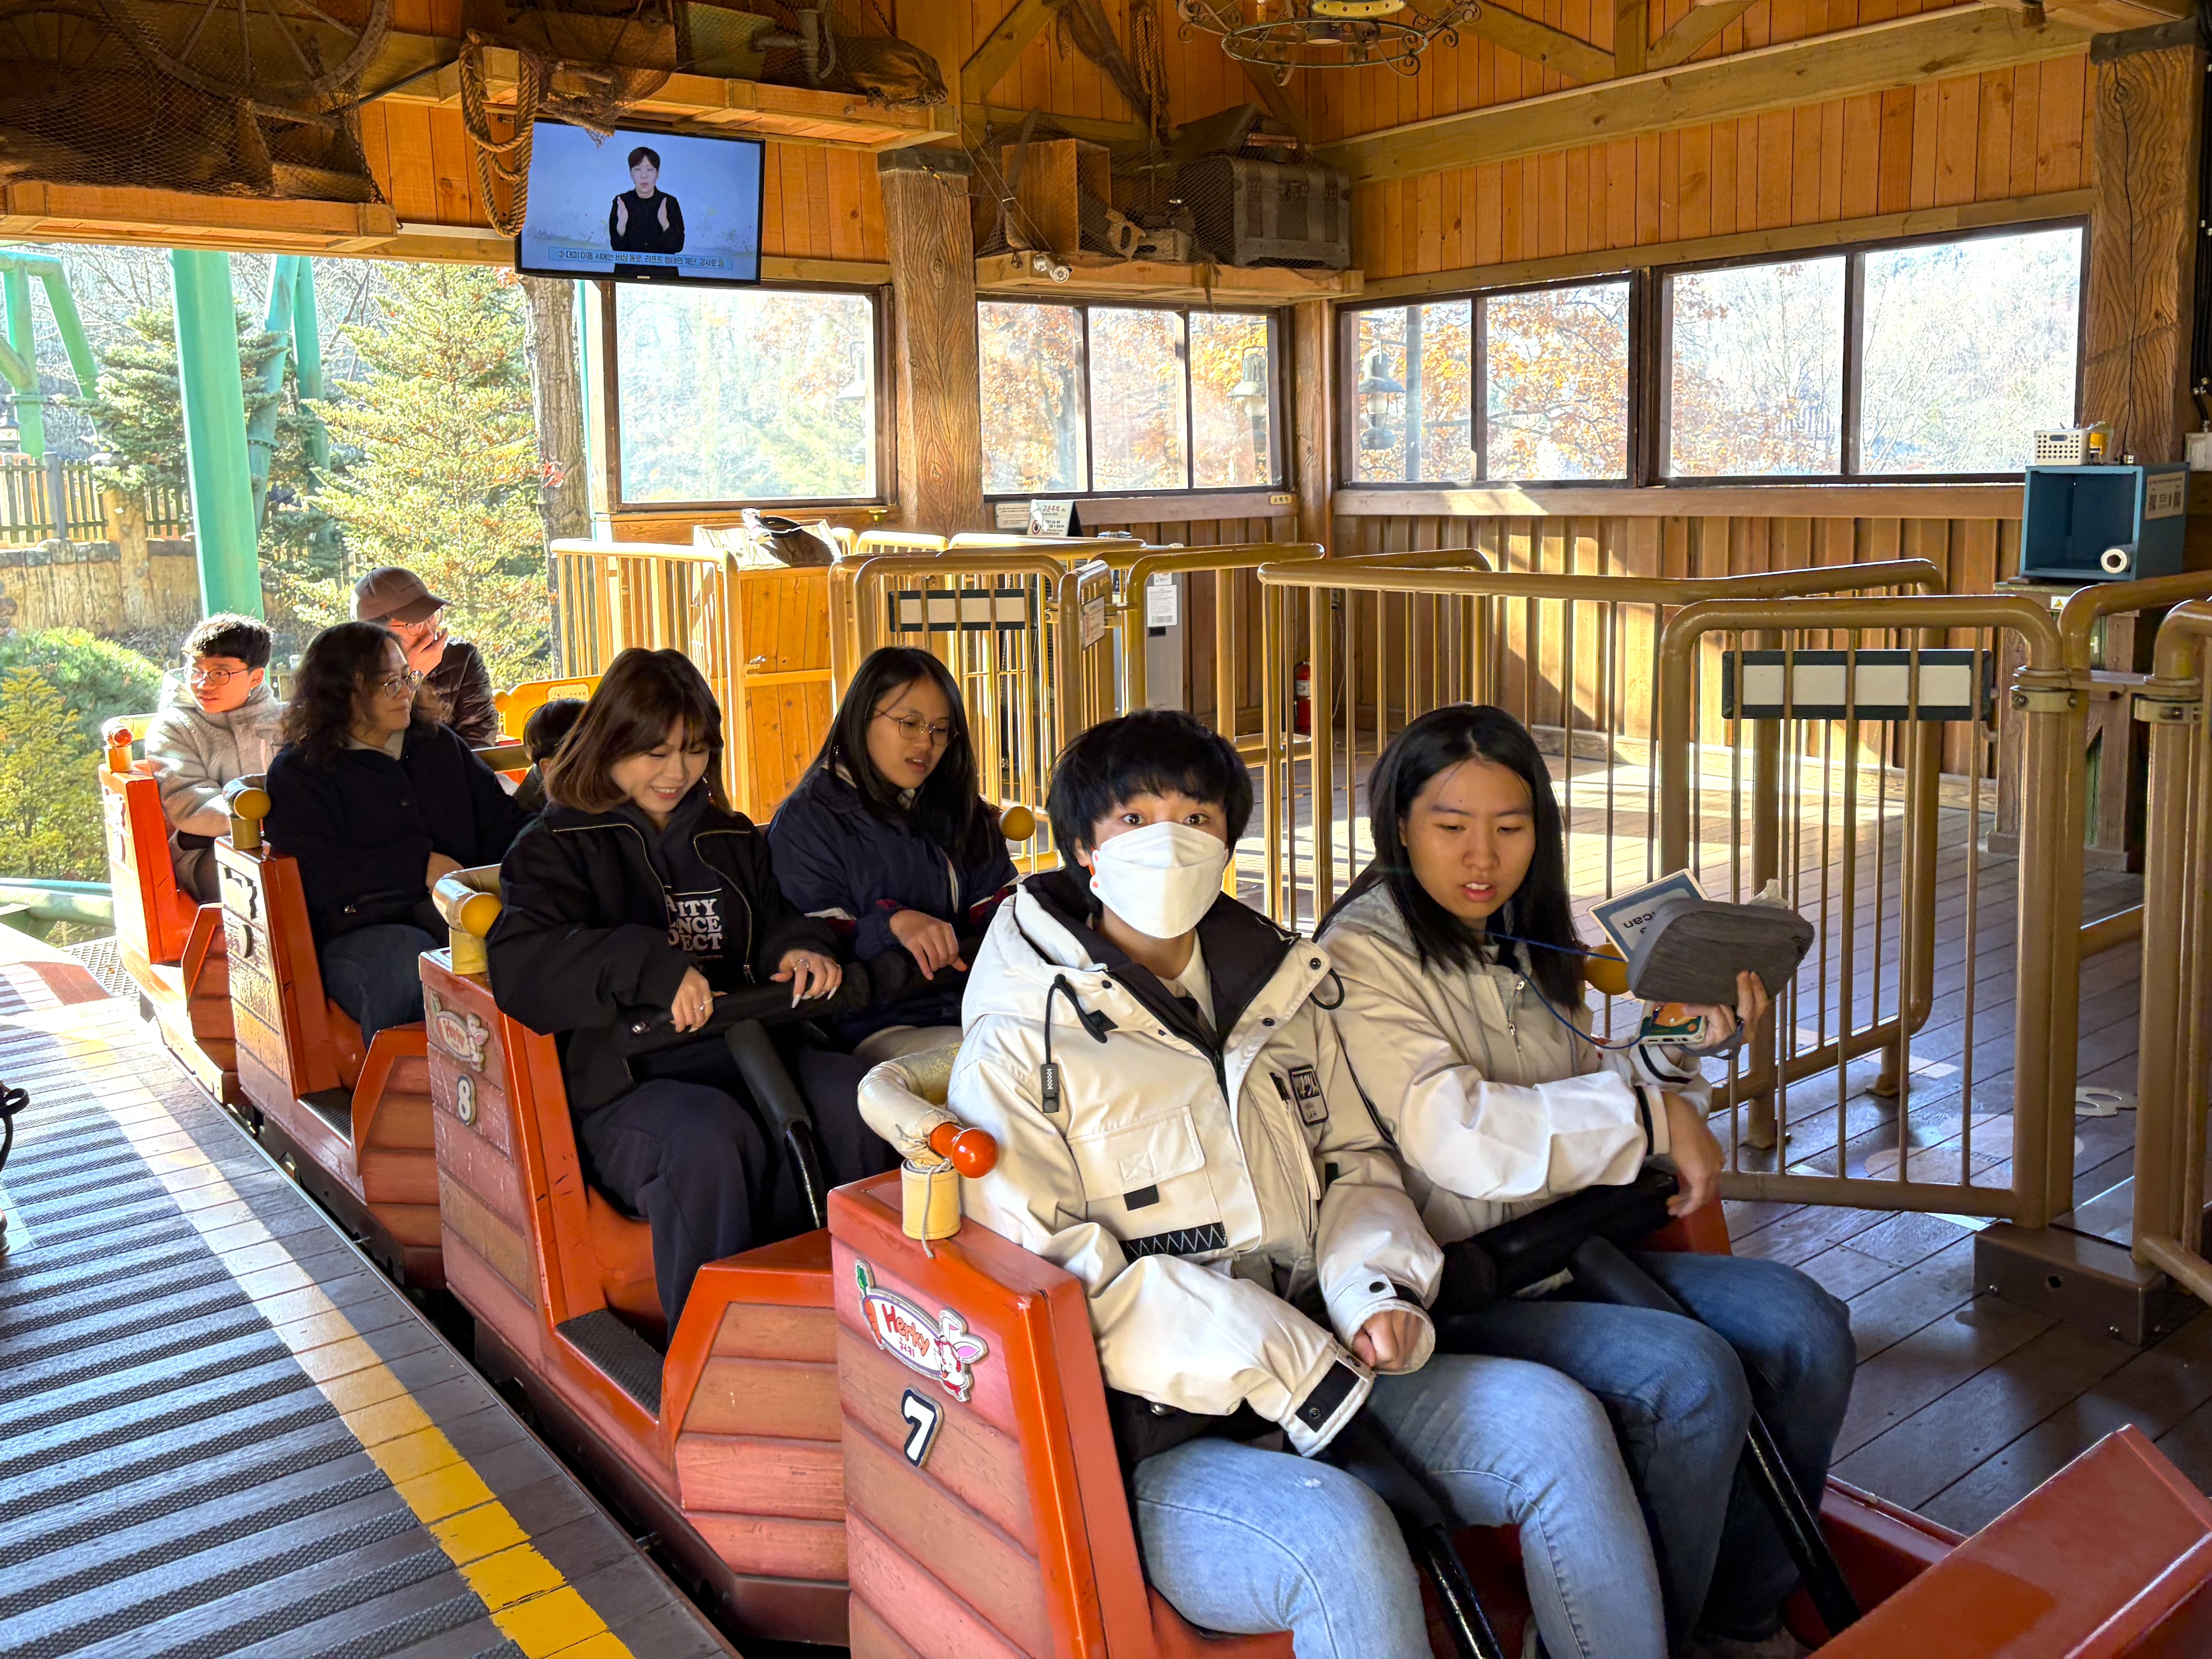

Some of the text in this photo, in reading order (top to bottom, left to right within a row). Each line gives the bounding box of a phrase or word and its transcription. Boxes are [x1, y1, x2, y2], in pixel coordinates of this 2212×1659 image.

[458, 1074, 472, 1125] 8
[882, 1303, 930, 1356] Herky
[899, 1337, 915, 1357] 허키
[901, 1389, 938, 1467] 7
